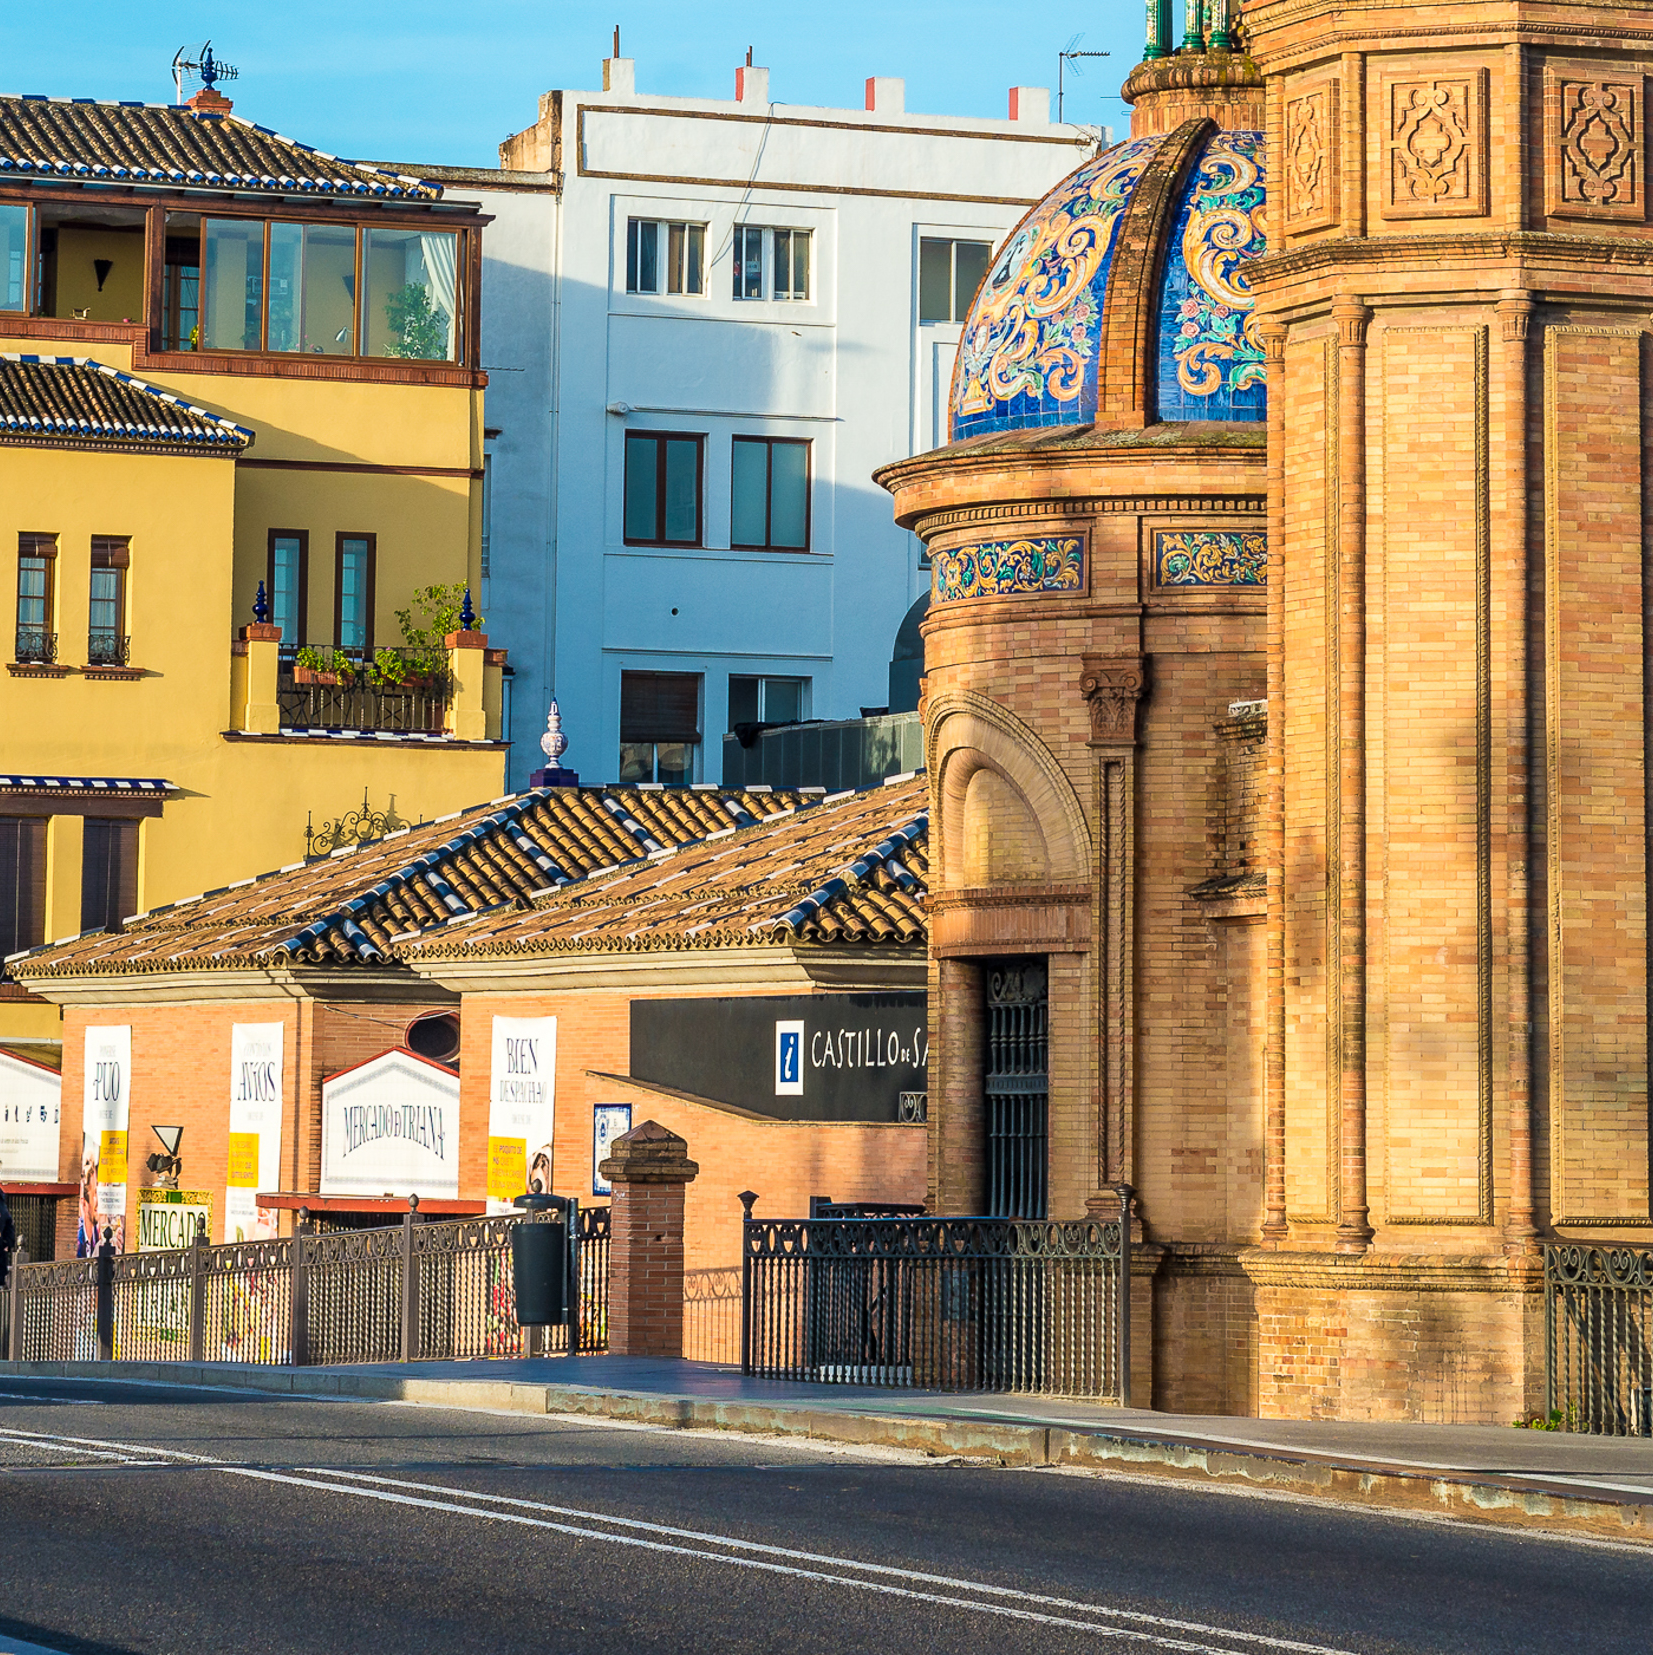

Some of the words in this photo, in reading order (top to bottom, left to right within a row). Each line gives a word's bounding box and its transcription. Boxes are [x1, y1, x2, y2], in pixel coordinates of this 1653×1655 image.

[506, 1037, 539, 1075] BIEN
[811, 1028, 899, 1069] CASTILLO
[901, 1047, 910, 1063] DE
[343, 1104, 393, 1159] MERCADO
[401, 1104, 446, 1161] TRIANA
